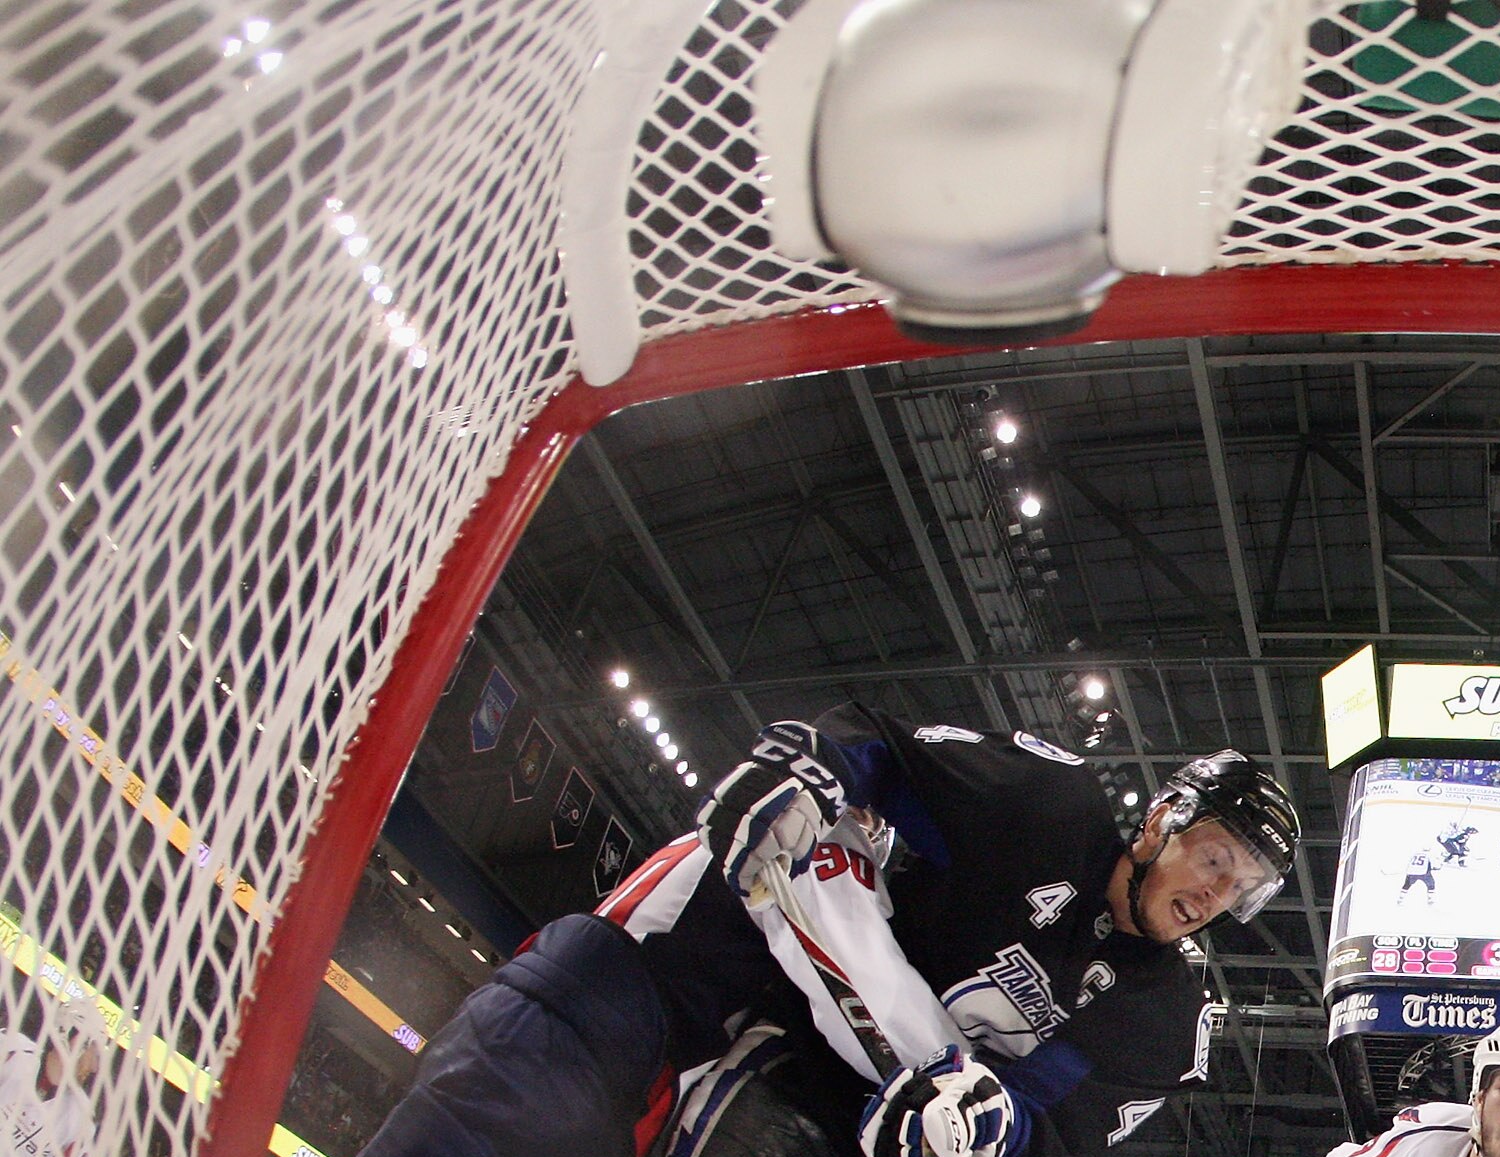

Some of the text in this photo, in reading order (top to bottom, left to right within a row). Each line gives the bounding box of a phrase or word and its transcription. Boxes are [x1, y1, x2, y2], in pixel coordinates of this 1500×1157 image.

[752, 739, 848, 817] CCM
[1261, 822, 1290, 853] CCM
[1025, 880, 1078, 930] 4
[1374, 952, 1398, 968] 28
[995, 951, 1051, 1024] TAMPA
[1075, 960, 1116, 1009] C
[1444, 993, 1495, 1008] Petersburg
[1402, 994, 1497, 1029] Times
